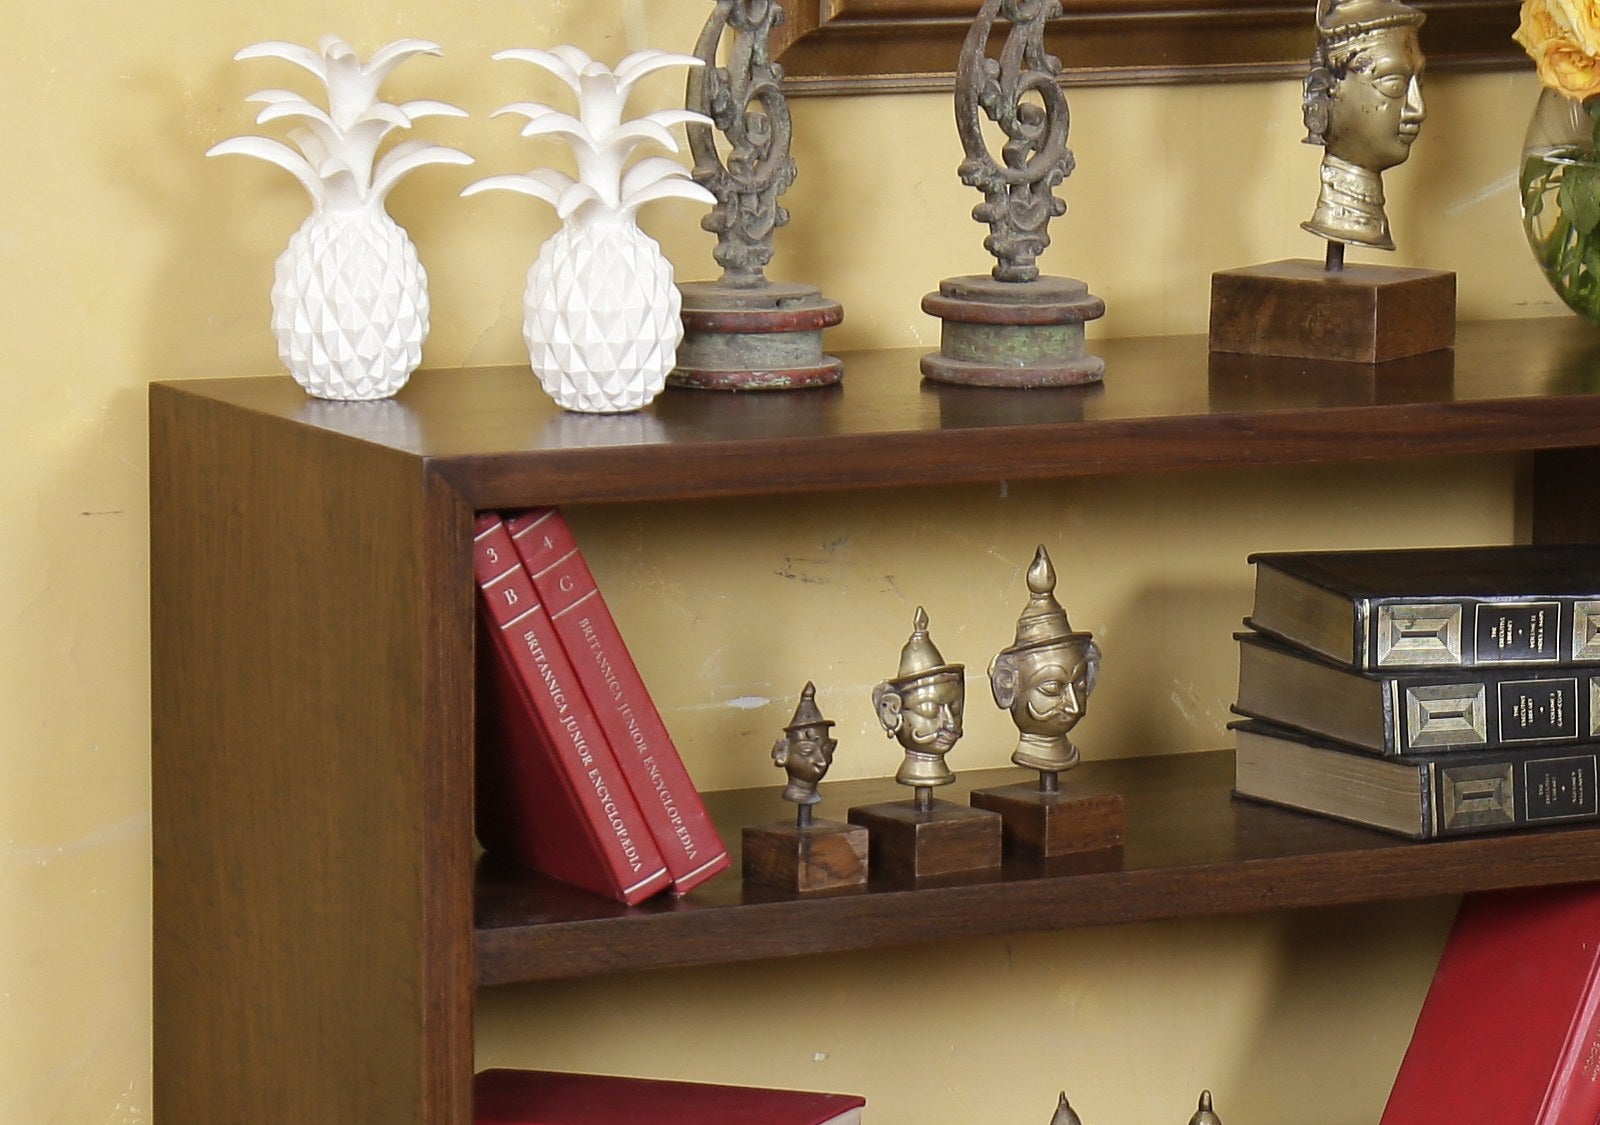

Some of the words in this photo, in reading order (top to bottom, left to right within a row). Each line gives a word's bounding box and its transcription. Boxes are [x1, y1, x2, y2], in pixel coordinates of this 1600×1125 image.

[486, 547, 499, 564] 3
[503, 588, 518, 606] B
[524, 630, 567, 713] BRITANNICA
[559, 715, 594, 767] JUNIOR
[579, 618, 622, 701] BRITANNICA
[617, 703, 647, 754] JUNIOR
